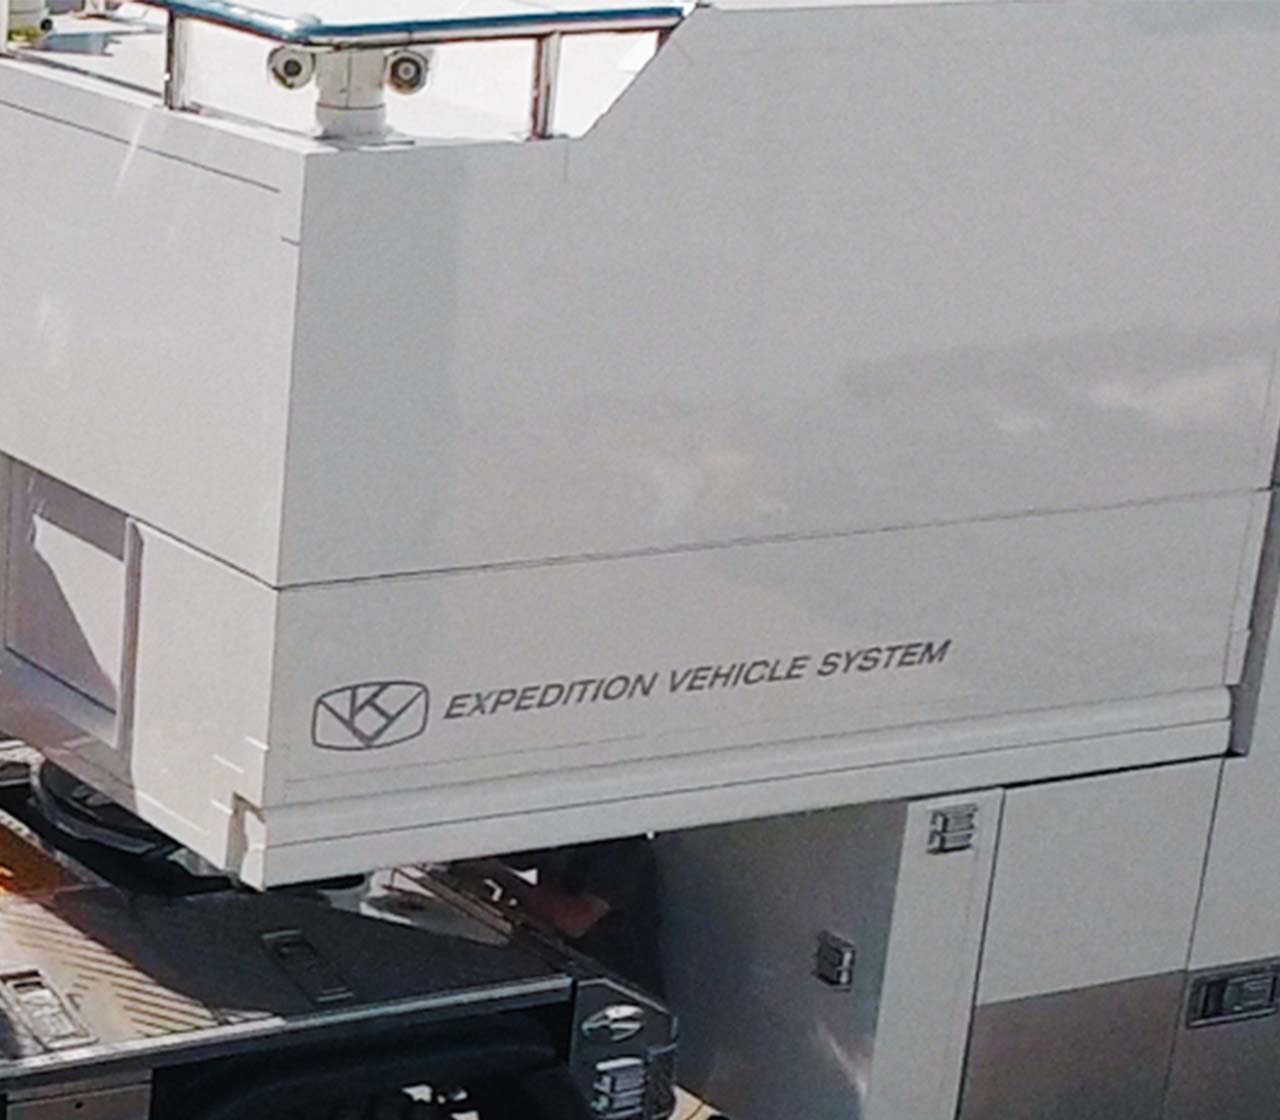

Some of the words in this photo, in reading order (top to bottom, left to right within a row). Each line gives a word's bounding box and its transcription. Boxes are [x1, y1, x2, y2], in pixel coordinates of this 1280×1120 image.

[442, 671, 658, 721] EXPEDITION
[668, 655, 811, 693] VEHICLE
[816, 639, 952, 677] SYSTEM
